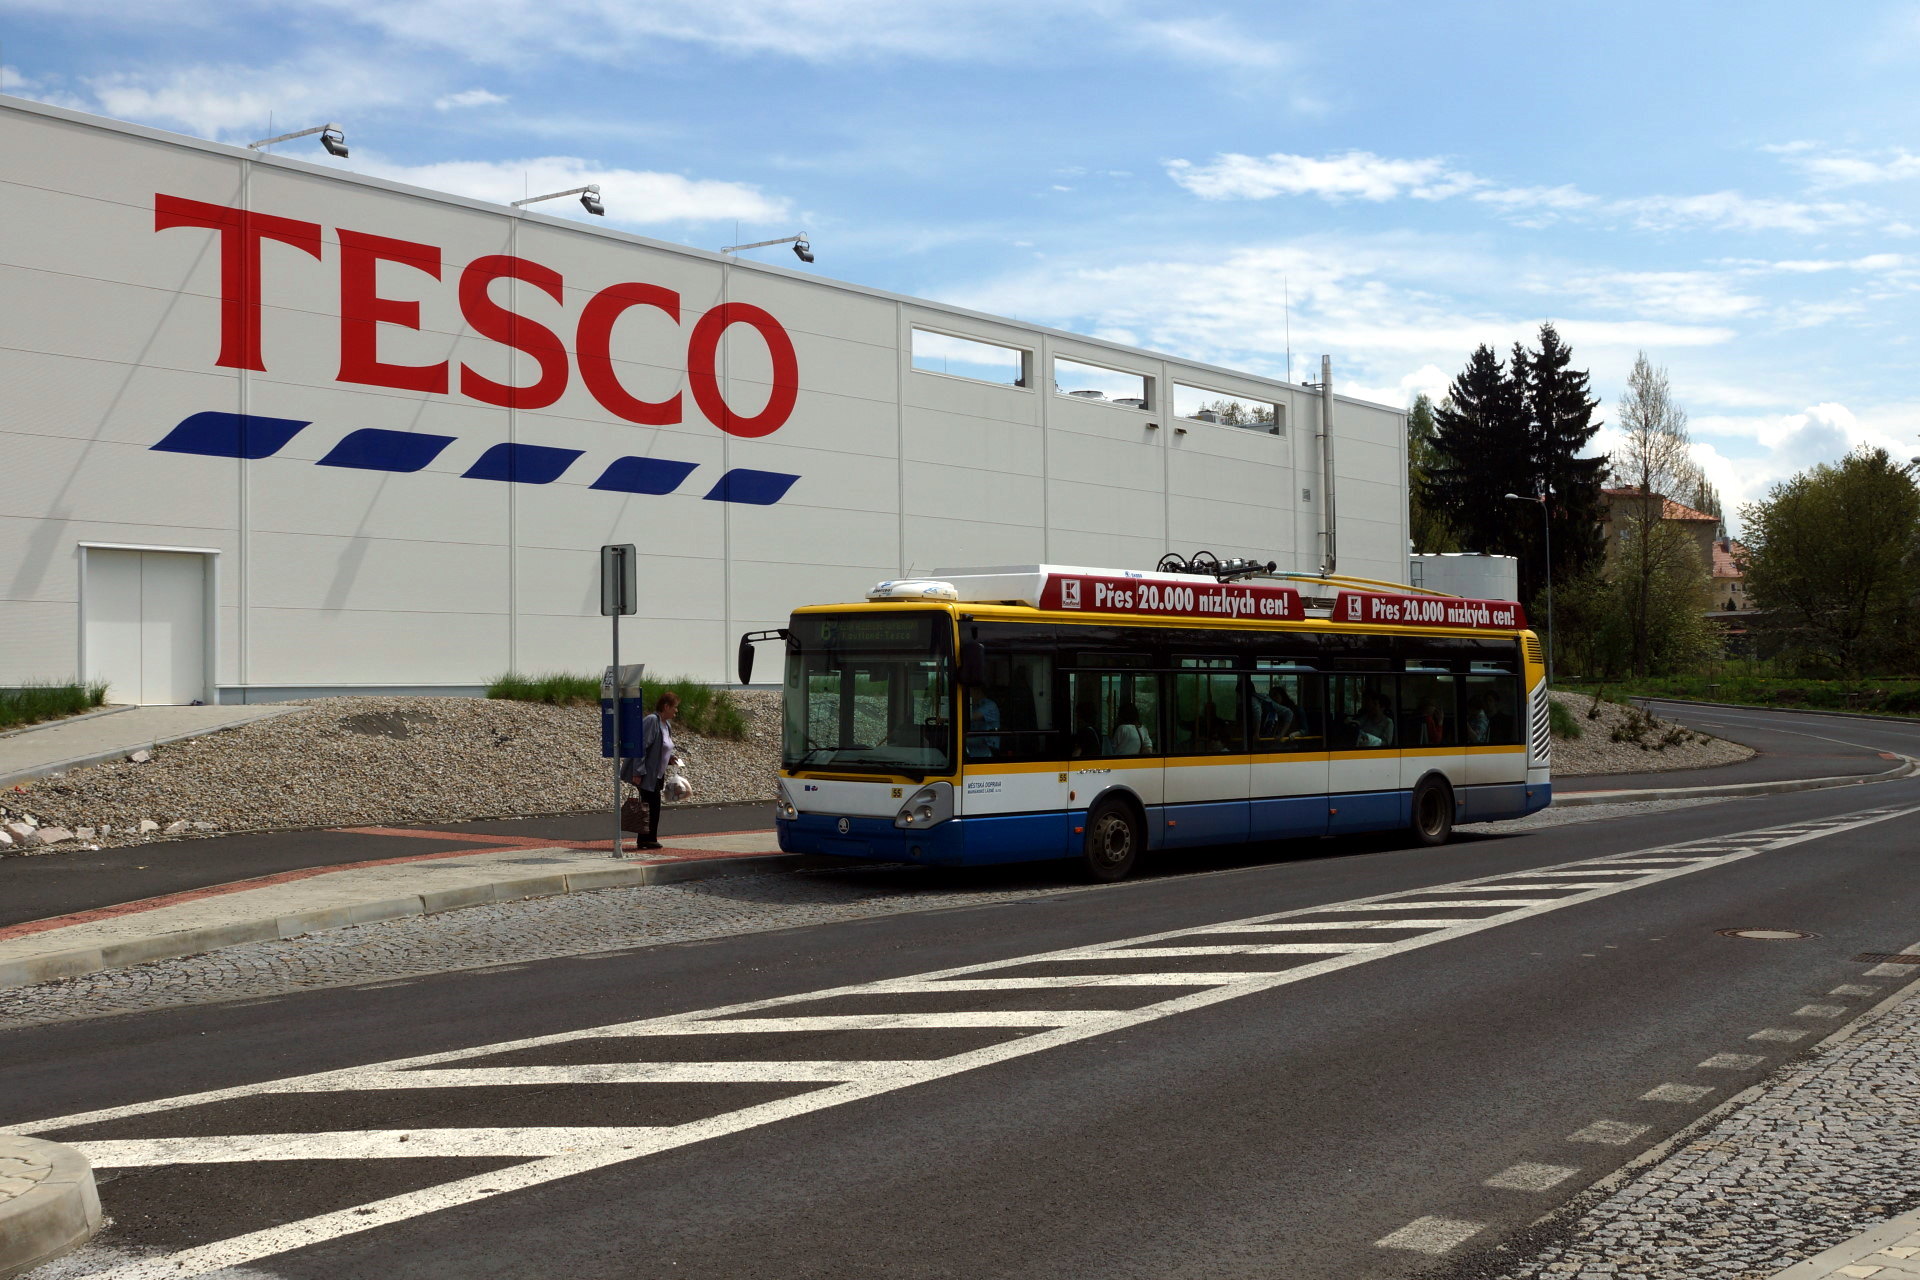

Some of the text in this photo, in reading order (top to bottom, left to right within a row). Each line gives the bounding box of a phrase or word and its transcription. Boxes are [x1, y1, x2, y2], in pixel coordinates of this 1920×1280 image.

[155, 192, 799, 438] TESCO
[1095, 582, 1289, 618] Přes 20.000 nízkých cen!
[1372, 598, 1515, 628] Přes 20.000 nízkých cen!
[821, 623, 830, 640] 6
[892, 788, 902, 798] 55
